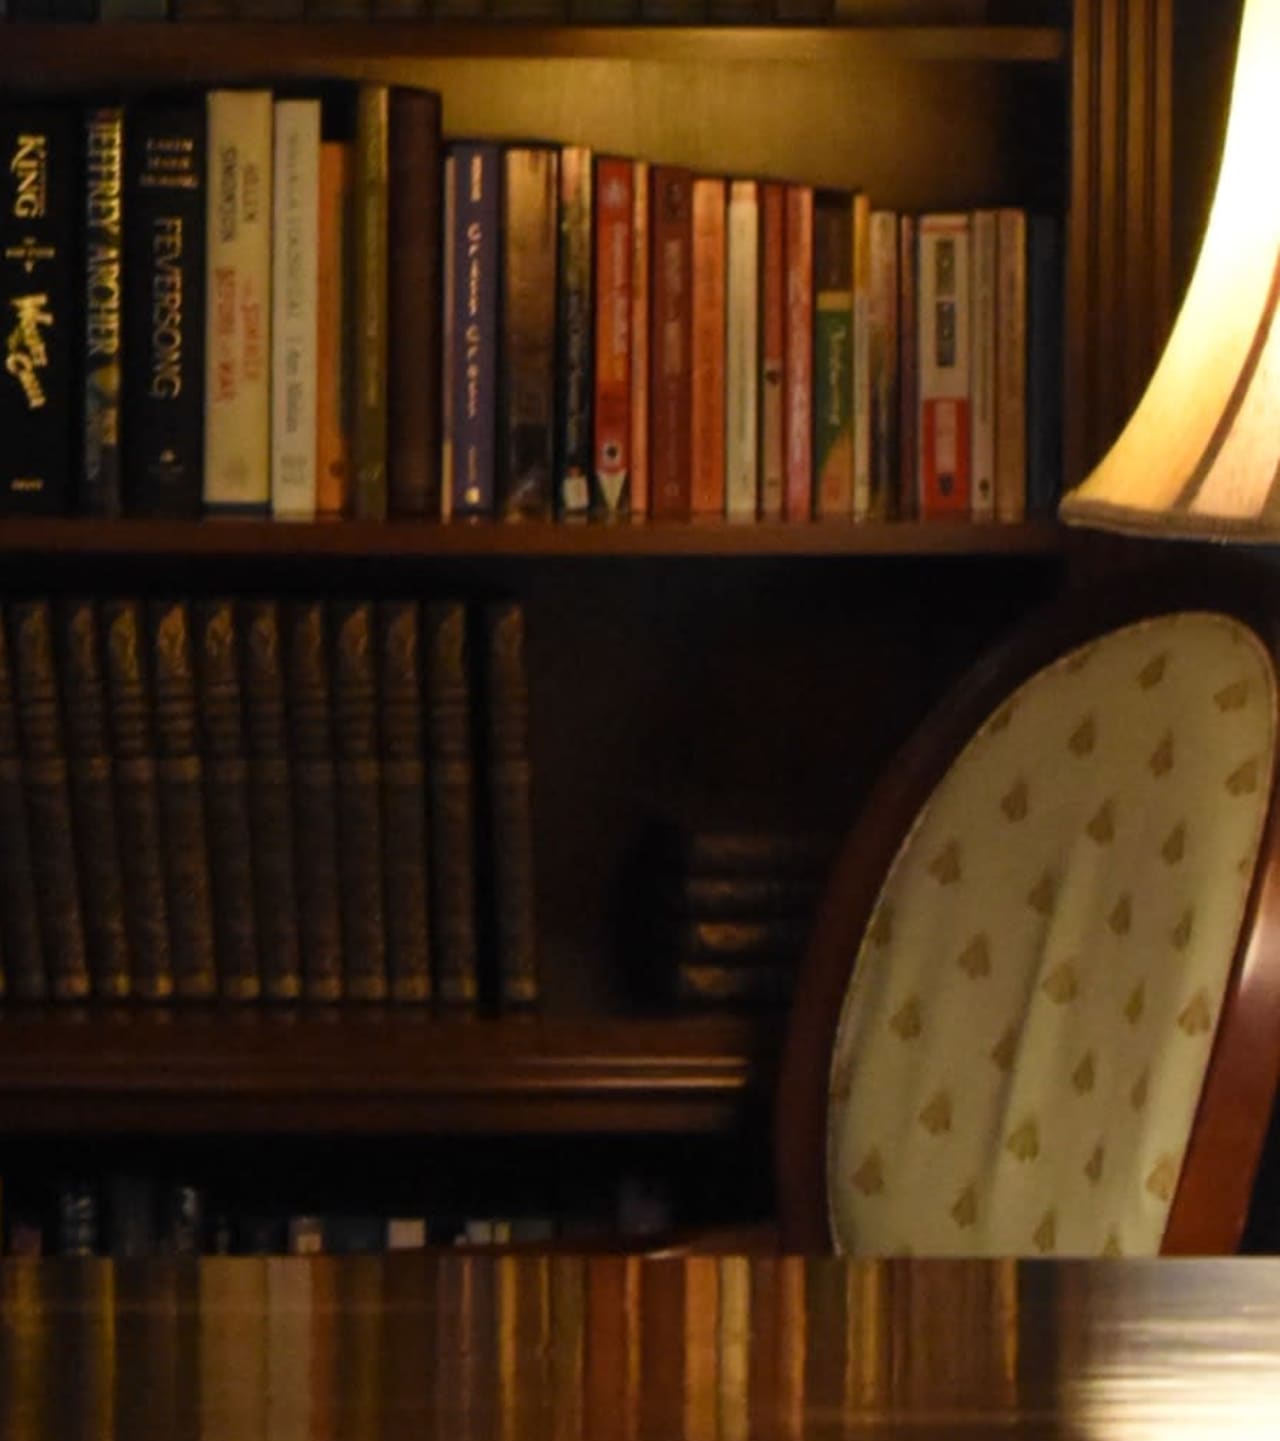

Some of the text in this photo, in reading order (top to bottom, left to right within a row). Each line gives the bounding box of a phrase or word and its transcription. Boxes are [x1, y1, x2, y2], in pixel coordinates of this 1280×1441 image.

[10, 132, 50, 219] KING
[85, 109, 124, 235] JEFFREY
[85, 244, 124, 357] ARCHER
[150, 215, 185, 400] FEVERSONG
